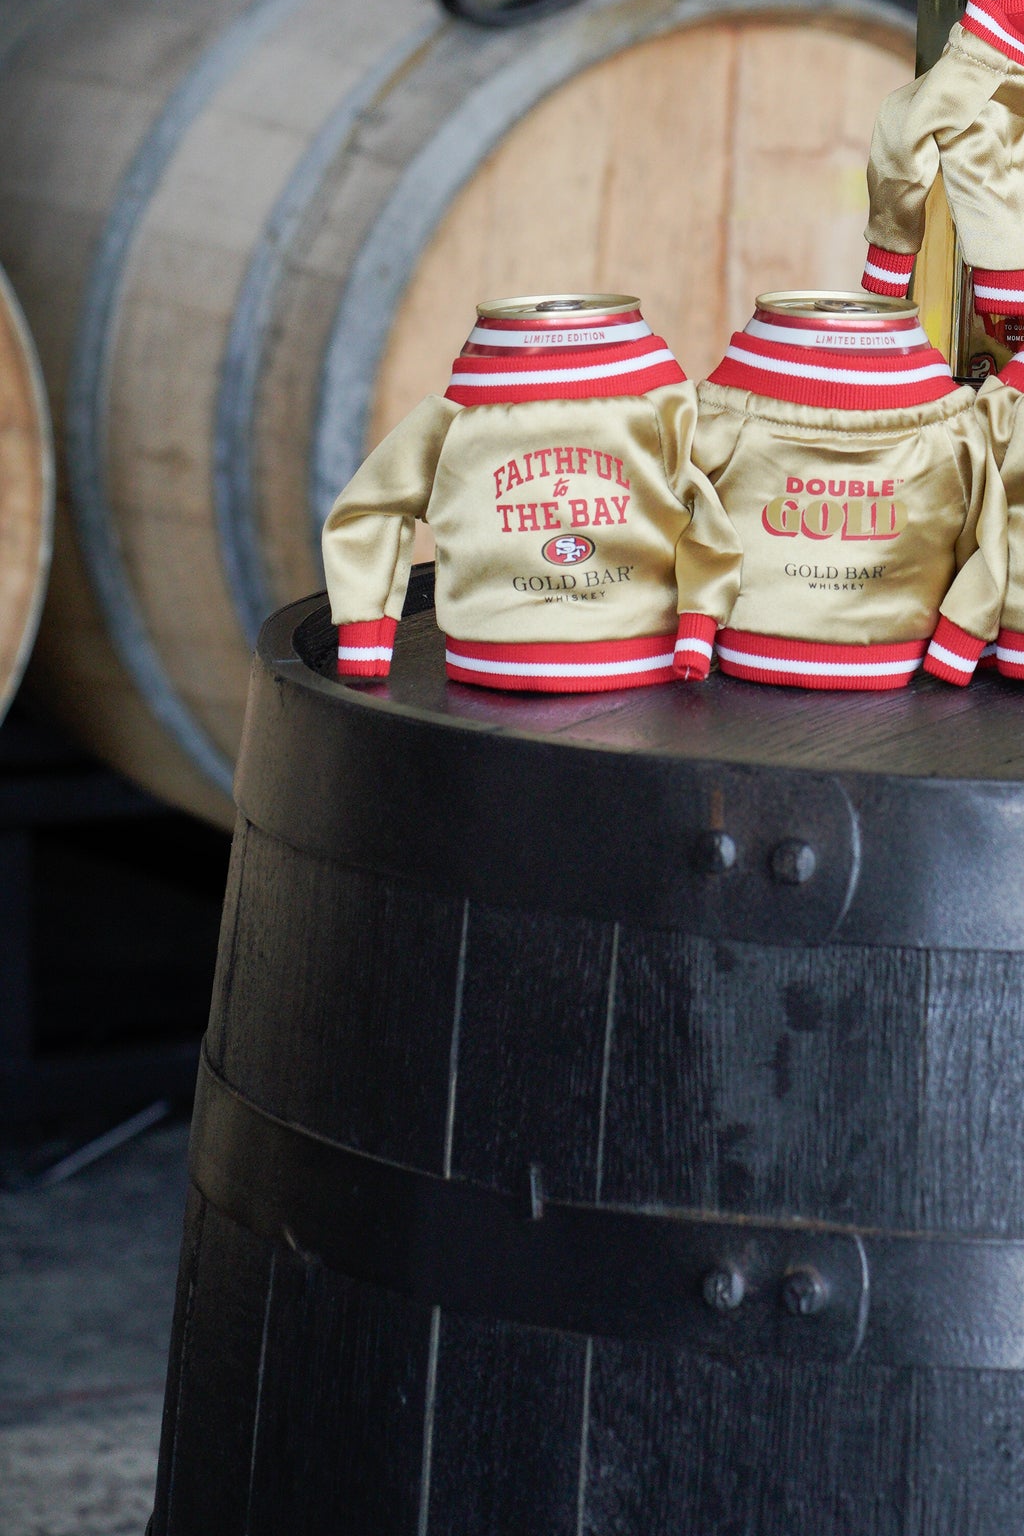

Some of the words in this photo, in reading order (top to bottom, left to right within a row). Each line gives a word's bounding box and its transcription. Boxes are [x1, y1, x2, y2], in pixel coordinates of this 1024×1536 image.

[523, 332, 563, 344] LIMITED
[567, 331, 606, 343] EDITION
[815, 335, 855, 345] LIMITED
[860, 335, 896, 345] EDITION
[493, 447, 631, 500] FAITHFUL
[552, 478, 570, 497] to
[496, 501, 561, 533] THE
[568, 495, 631, 528] BAY
[761, 496, 908, 541] GOLD
[555, 537, 586, 563] SF
[784, 563, 839, 579] GOLD
[512, 574, 577, 592] GOLD
[808, 582, 865, 591] WHISKEY
[544, 590, 606, 603] WHISKEY
